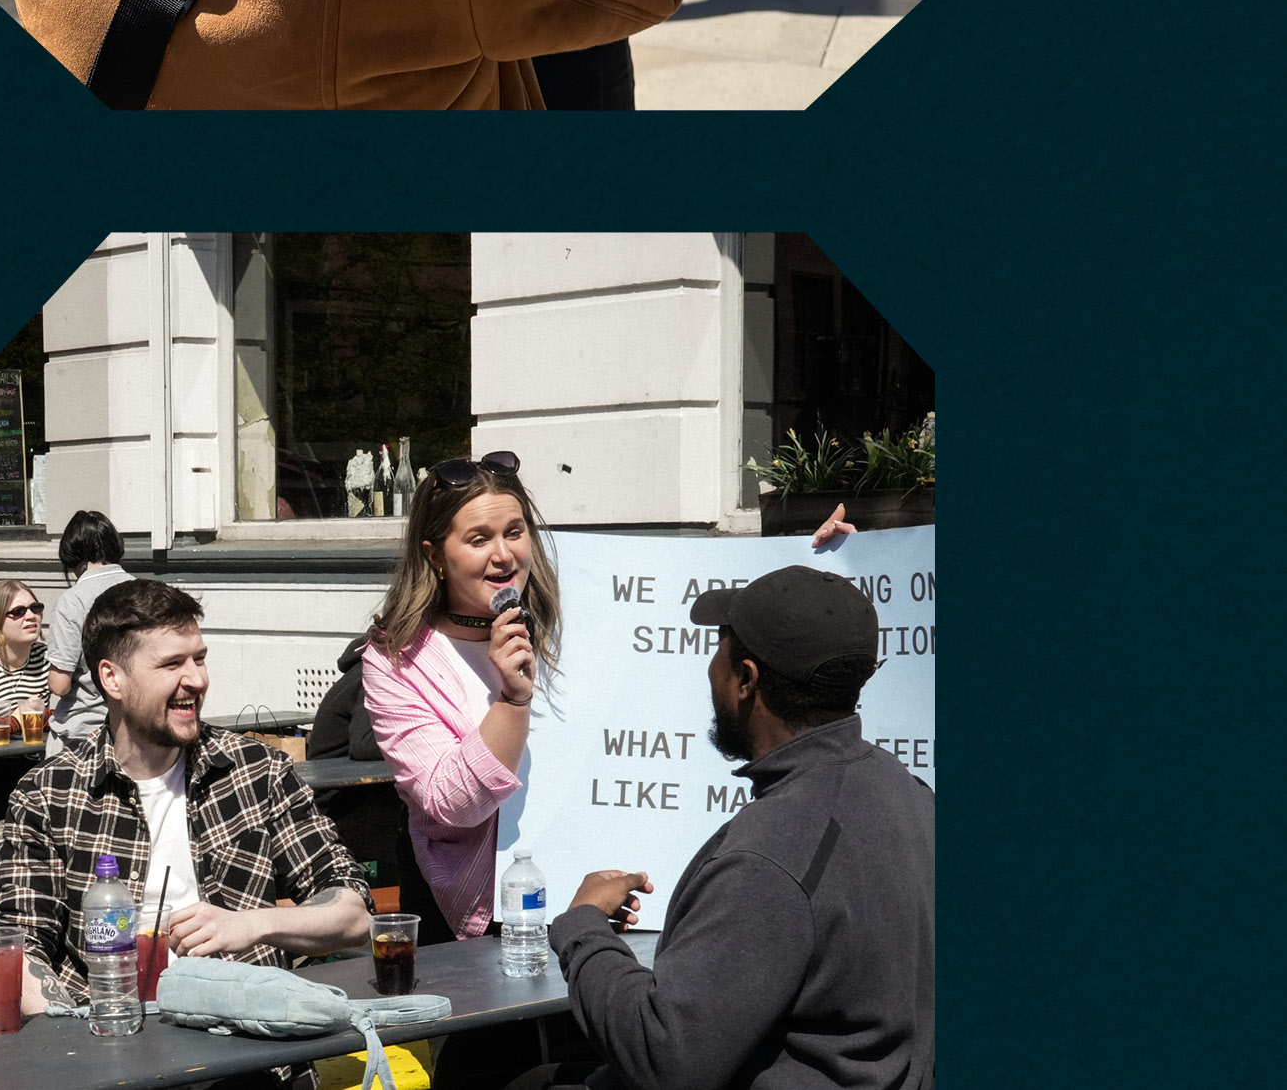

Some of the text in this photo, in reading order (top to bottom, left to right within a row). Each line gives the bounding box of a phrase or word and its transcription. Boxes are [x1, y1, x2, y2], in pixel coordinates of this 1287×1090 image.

[612, 575, 656, 604] WE
[603, 728, 696, 760] WHAT
[590, 778, 680, 811] LIKE
